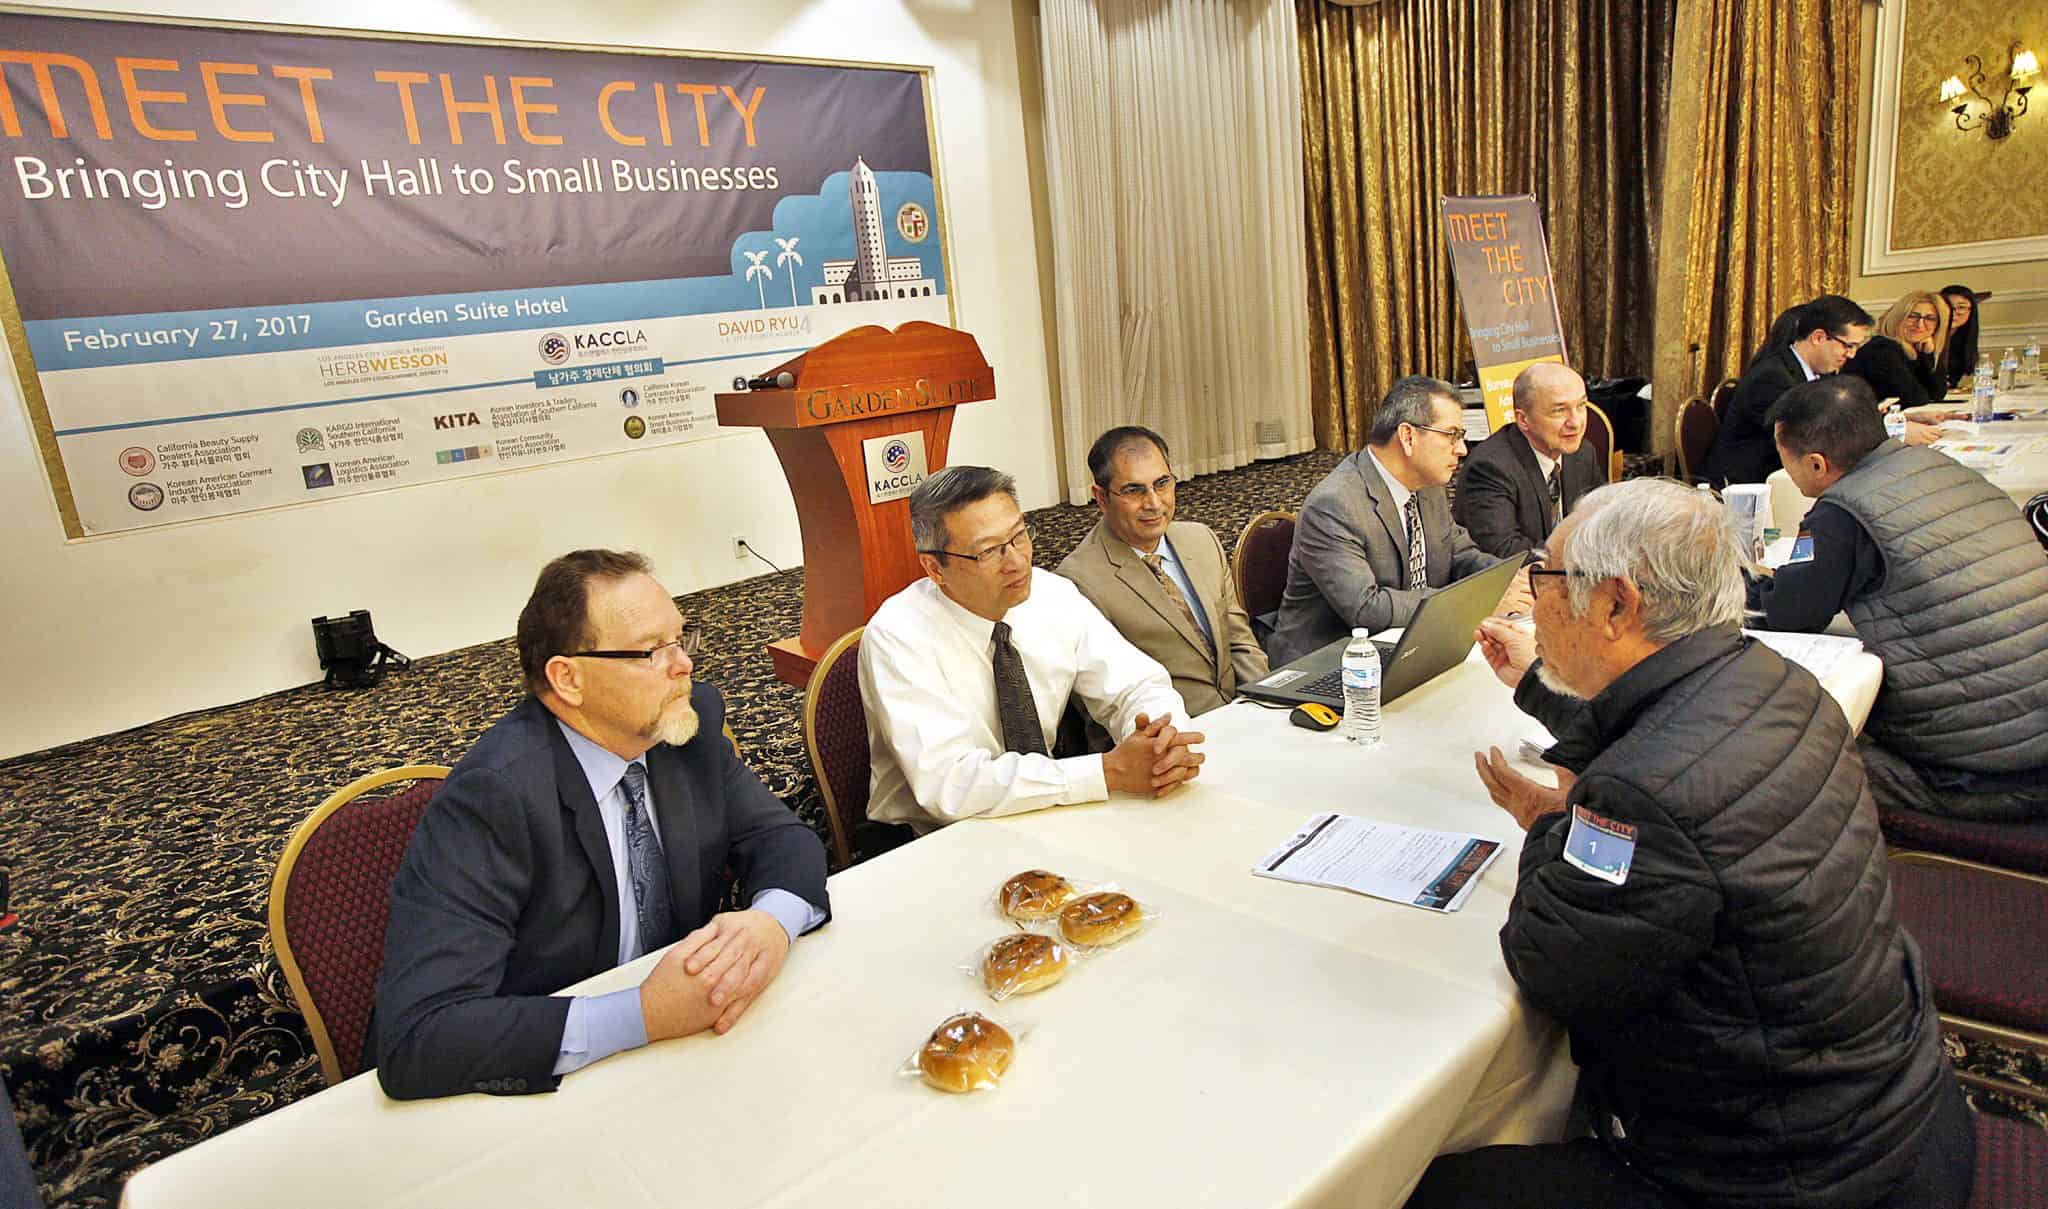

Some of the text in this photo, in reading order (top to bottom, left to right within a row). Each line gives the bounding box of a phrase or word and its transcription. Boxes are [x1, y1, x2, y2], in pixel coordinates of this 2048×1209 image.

[0, 50, 767, 147] MEET THE CITY
[14, 156, 779, 210] Bringing City Hall to Small Businesses
[1448, 211, 1508, 243] MEET
[1481, 246, 1525, 274] THE
[1503, 276, 1549, 305] CITY
[365, 296, 568, 329] Garden Suite Hotel
[63, 315, 311, 351] February 27, 2017
[719, 320, 765, 336] DAVID
[769, 316, 798, 331] RYU
[574, 329, 648, 350] KACCLA
[548, 361, 653, 385] 남가주 경제단체 협의회
[490, 405, 515, 413] Korean
[491, 409, 531, 420] Association
[568, 400, 598, 410] California
[355, 418, 401, 430] International
[433, 411, 481, 430] KITA
[327, 426, 396, 440] Southern California
[495, 437, 518, 446] Korean
[157, 434, 259, 453] California Beauty Supply
[159, 445, 241, 461] Dealers Association
[526, 438, 560, 449] Association
[335, 454, 395, 467] Korean American
[336, 460, 410, 477] Logistics Association
[166, 467, 272, 489] Korean American Garment
[169, 479, 252, 496] Industry Association
[874, 472, 923, 492] KACCLA
[1611, 822, 1634, 834] CITY
[1589, 841, 1597, 855] 1
